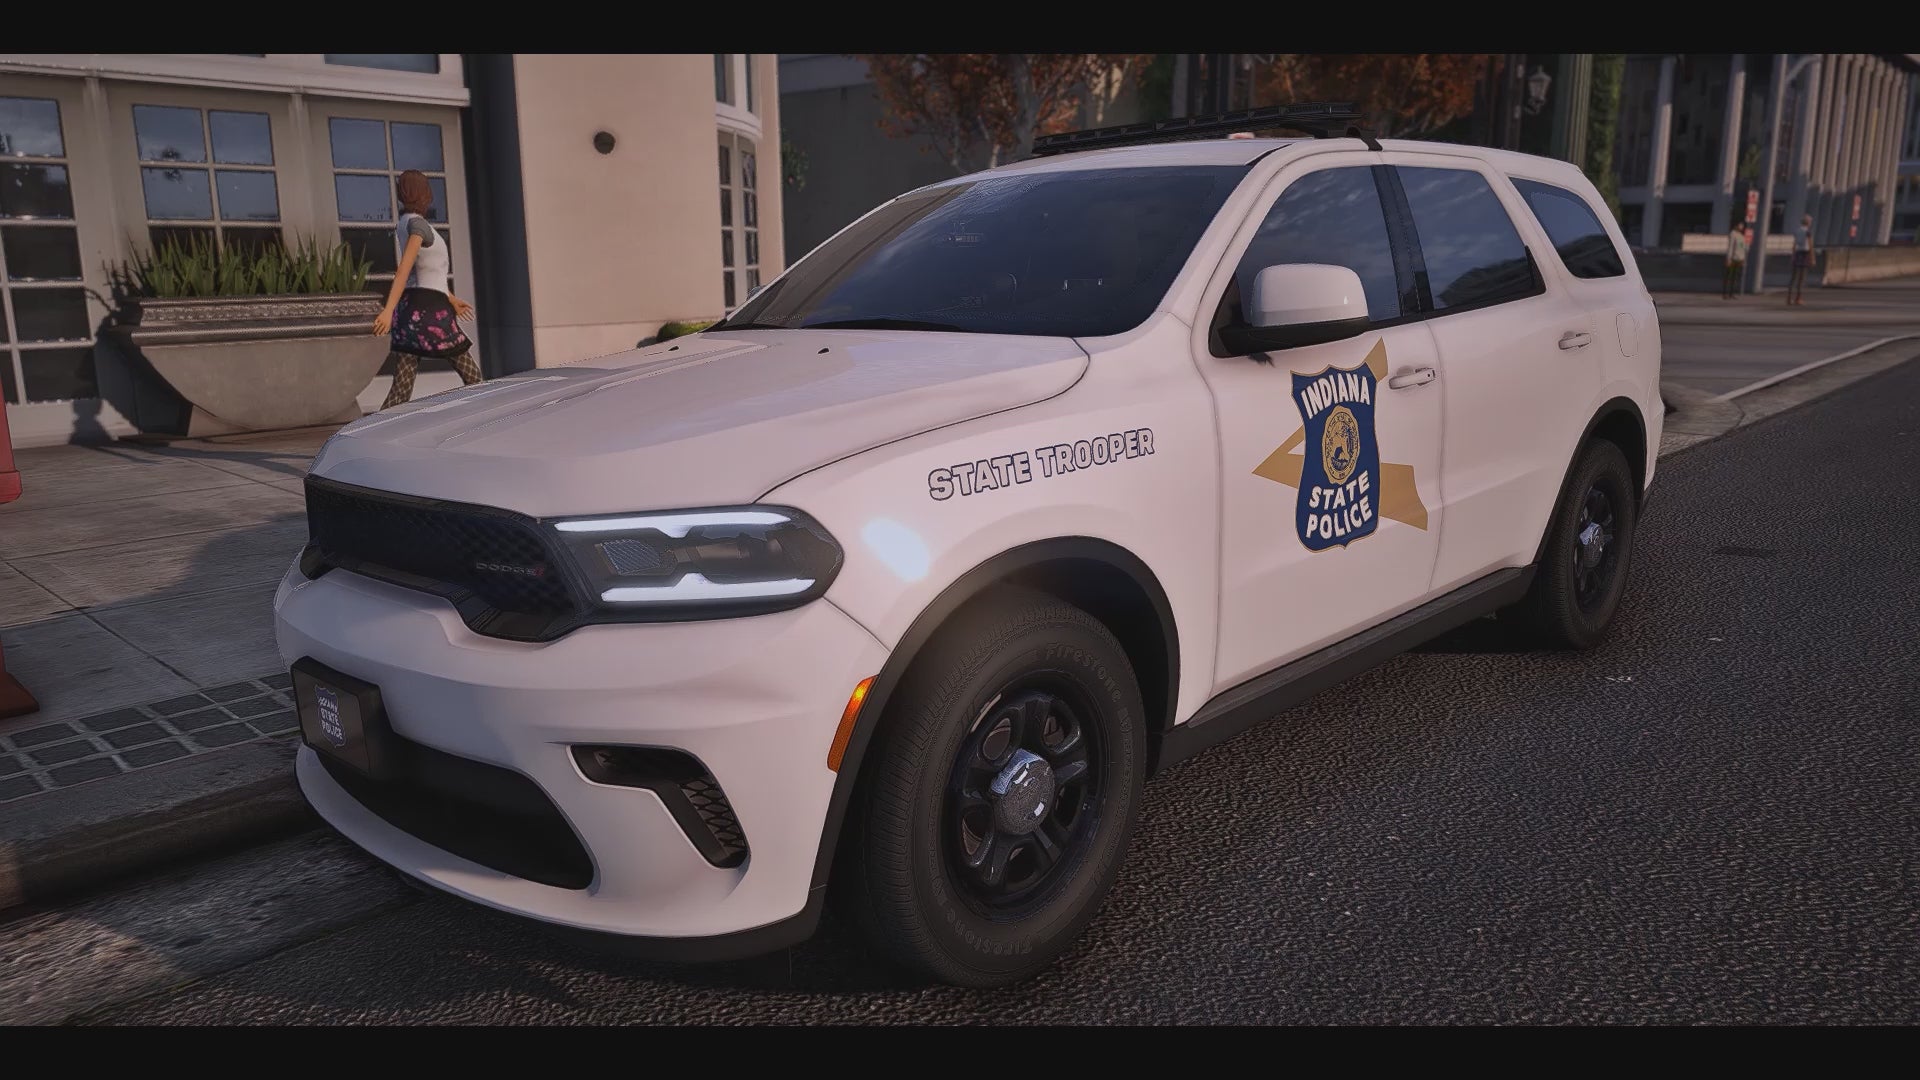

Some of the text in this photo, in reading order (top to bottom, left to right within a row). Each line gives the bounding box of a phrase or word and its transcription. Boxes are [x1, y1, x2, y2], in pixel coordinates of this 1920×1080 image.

[1301, 373, 1370, 419] INDIANA
[928, 427, 1155, 501] STATE TROOPER
[1309, 470, 1370, 510] STATE
[1305, 495, 1373, 539] POLICE
[476, 562, 536, 576] DODGE
